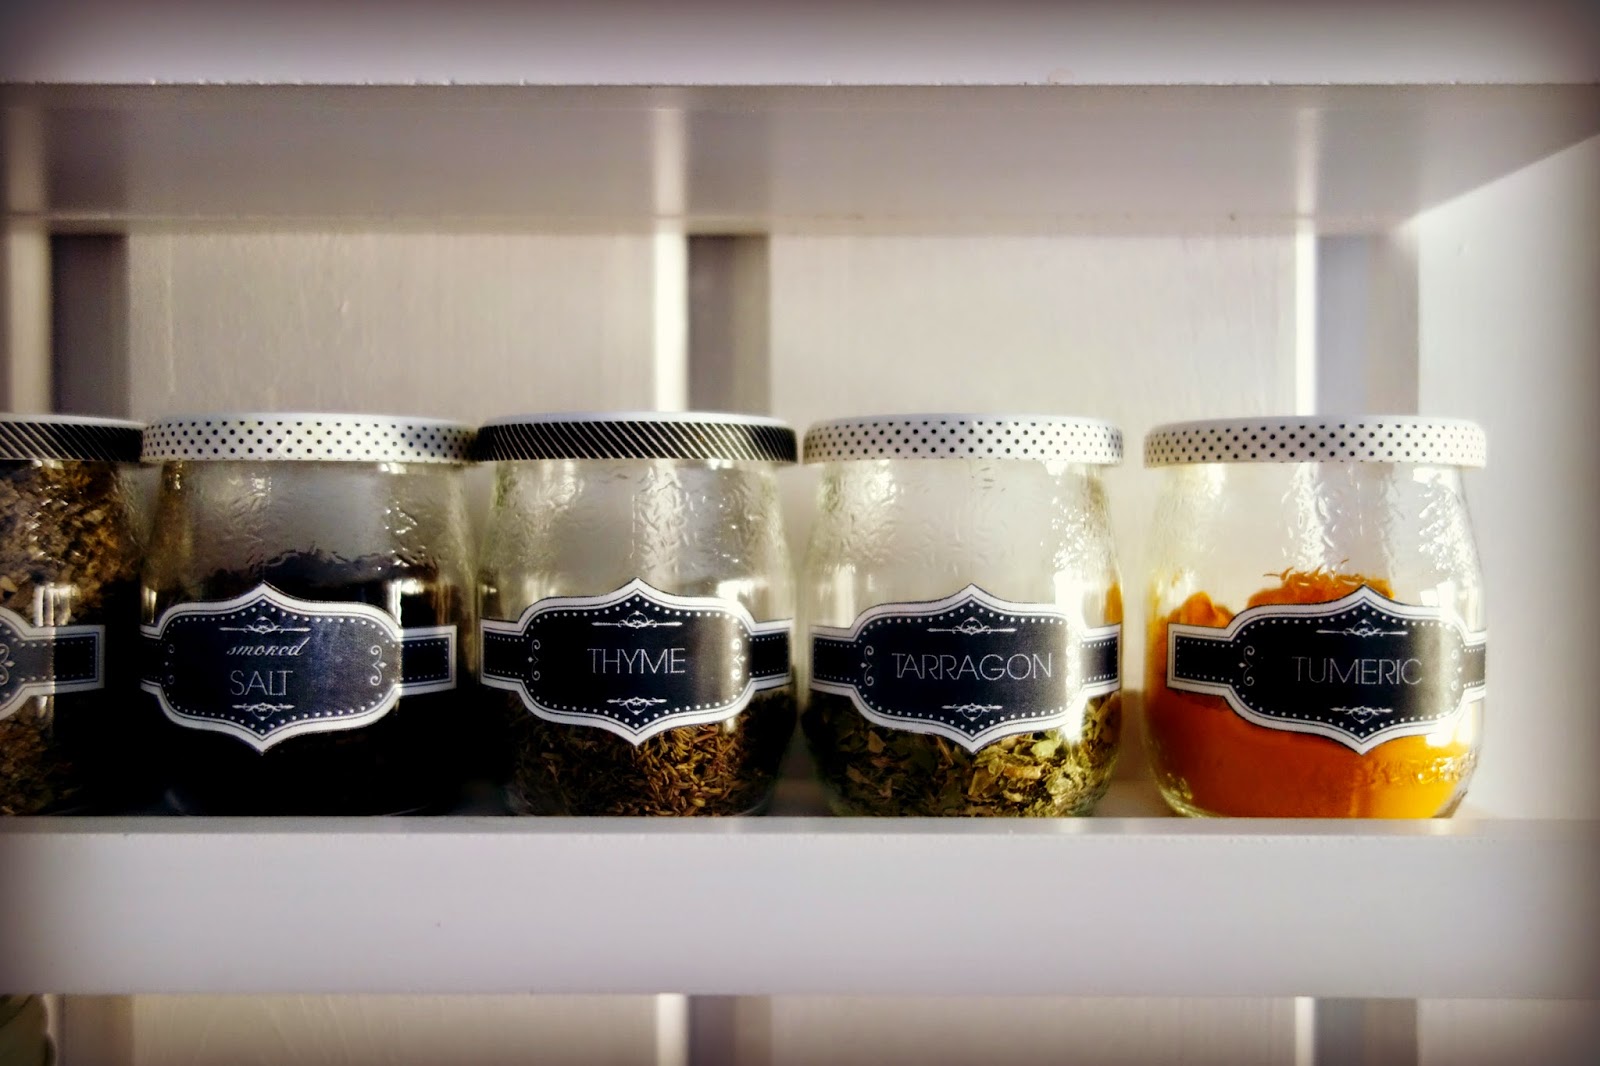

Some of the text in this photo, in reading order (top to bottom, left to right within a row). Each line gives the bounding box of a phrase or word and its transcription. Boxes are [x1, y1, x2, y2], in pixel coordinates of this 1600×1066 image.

[586, 647, 686, 674] THYME
[891, 652, 1052, 681] TARRAGON
[1291, 656, 1423, 686] TUMERIC
[229, 669, 294, 697] SALT
